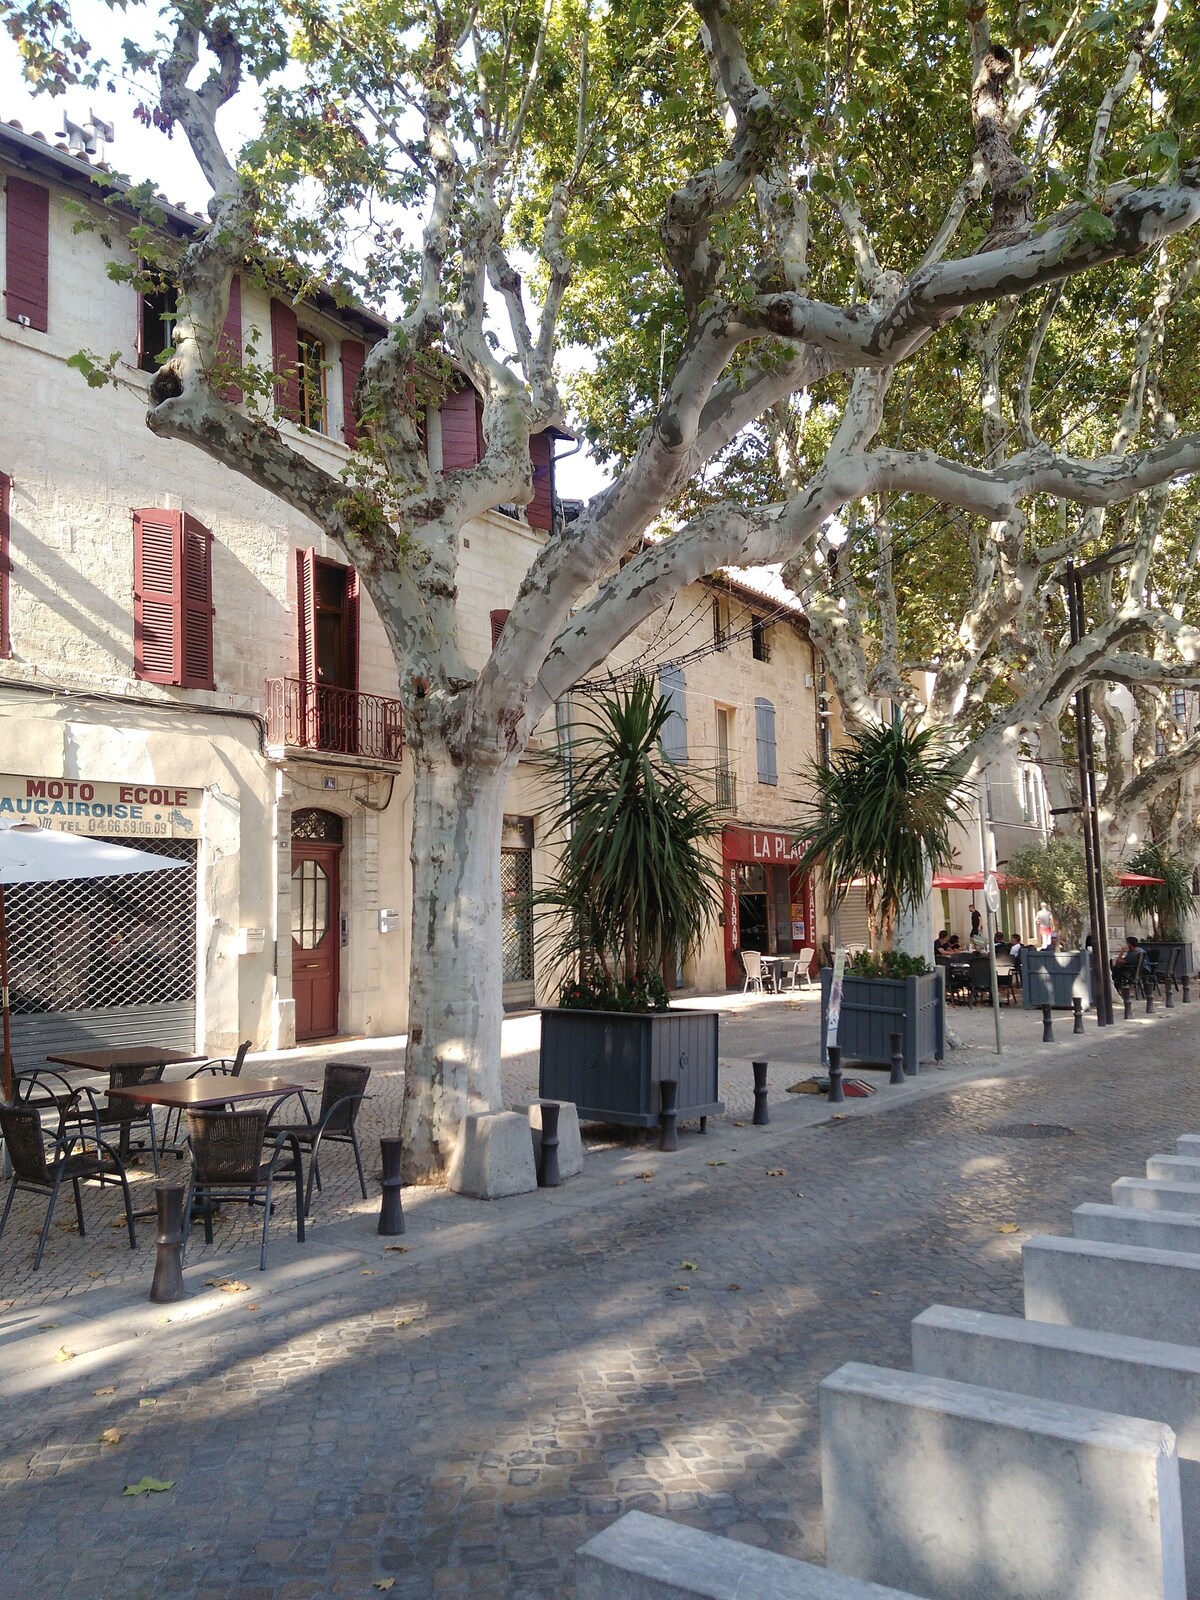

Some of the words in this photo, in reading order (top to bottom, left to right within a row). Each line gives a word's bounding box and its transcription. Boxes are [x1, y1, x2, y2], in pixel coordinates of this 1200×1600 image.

[26, 779, 95, 801] MOTO
[119, 786, 188, 806] ECOLE
[0, 797, 143, 819] AUCAIROISE
[753, 834, 771, 858] LA
[730, 868, 738, 950] RESTAURANT
